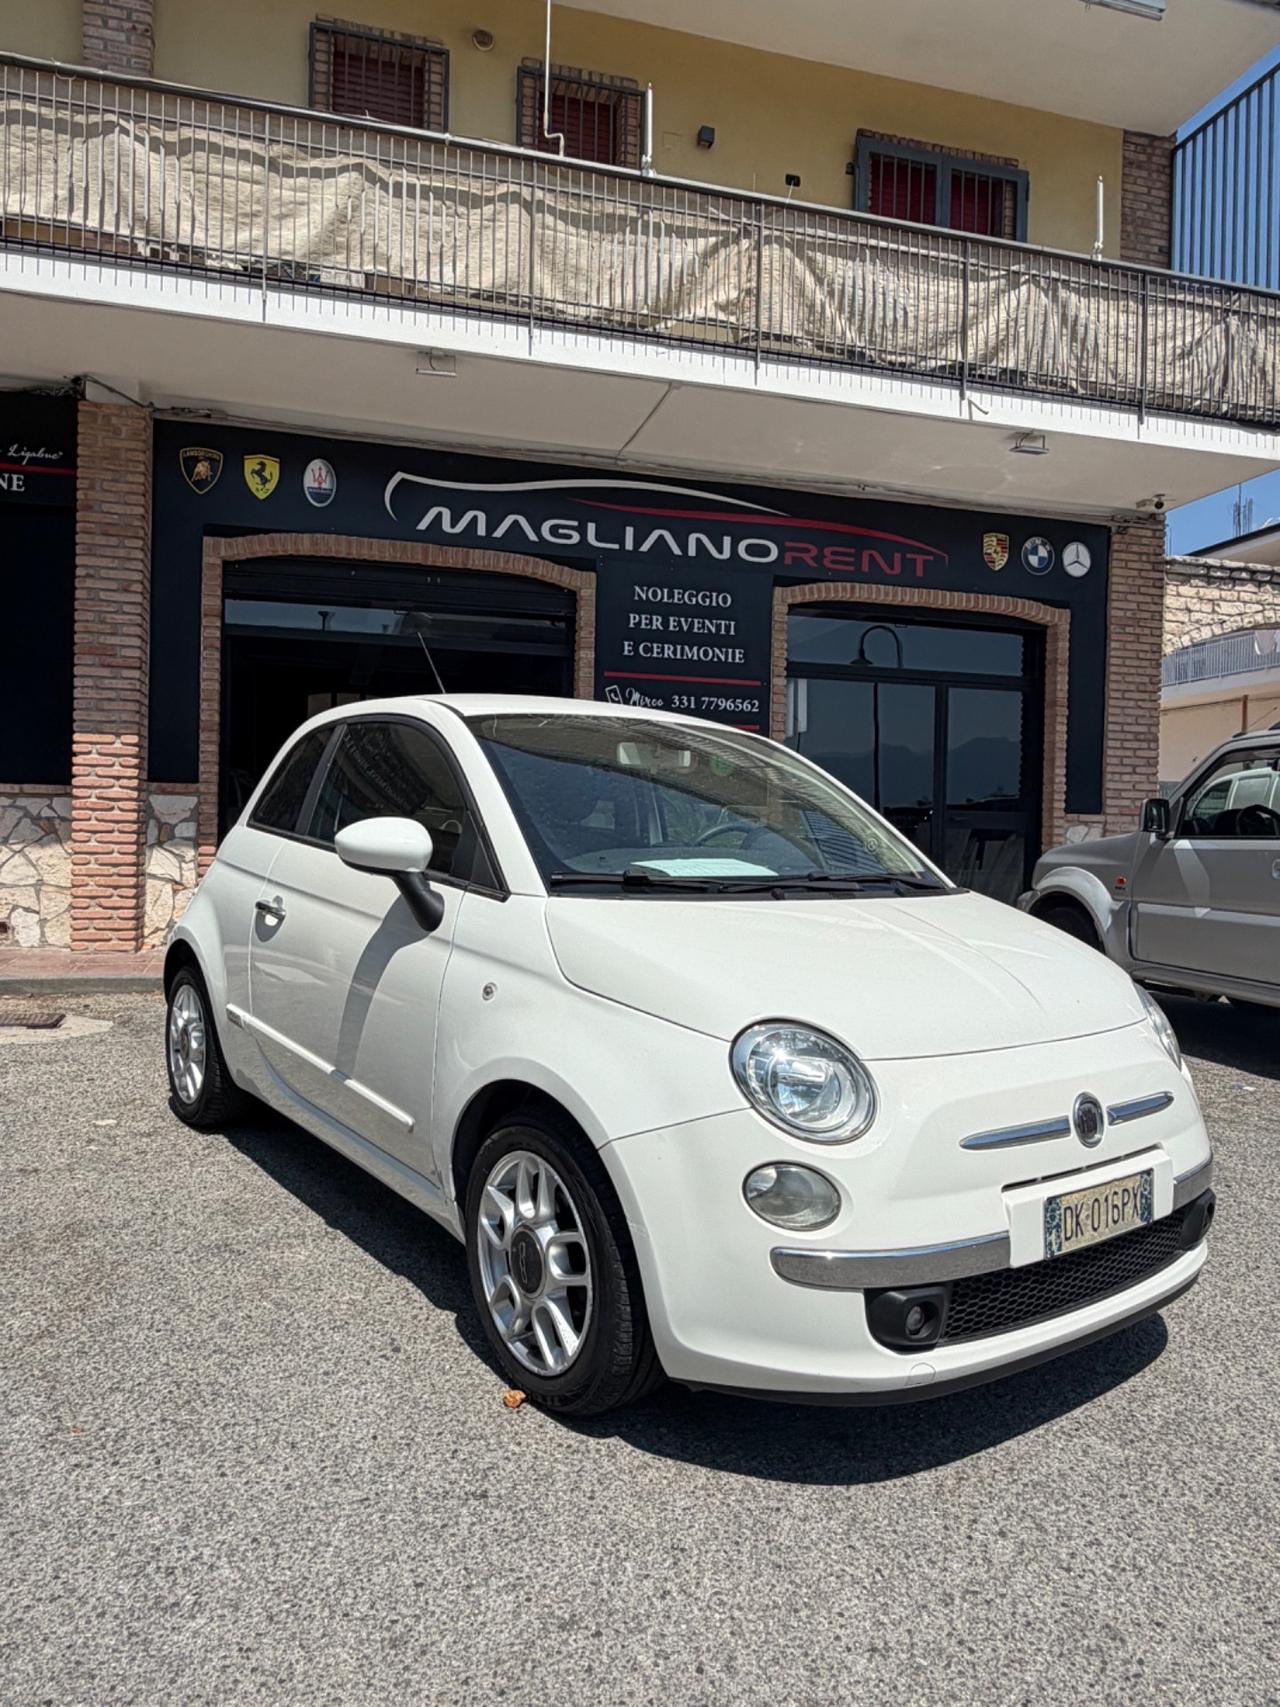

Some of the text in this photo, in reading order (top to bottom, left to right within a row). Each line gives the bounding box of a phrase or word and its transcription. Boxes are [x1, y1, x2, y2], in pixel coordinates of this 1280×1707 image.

[634, 586, 732, 607] NOLEGGIO
[629, 613, 736, 635] PER EVENTI
[623, 641, 745, 663] E CERIMONIE
[671, 695, 696, 708] 331
[701, 697, 760, 712] 7796562
